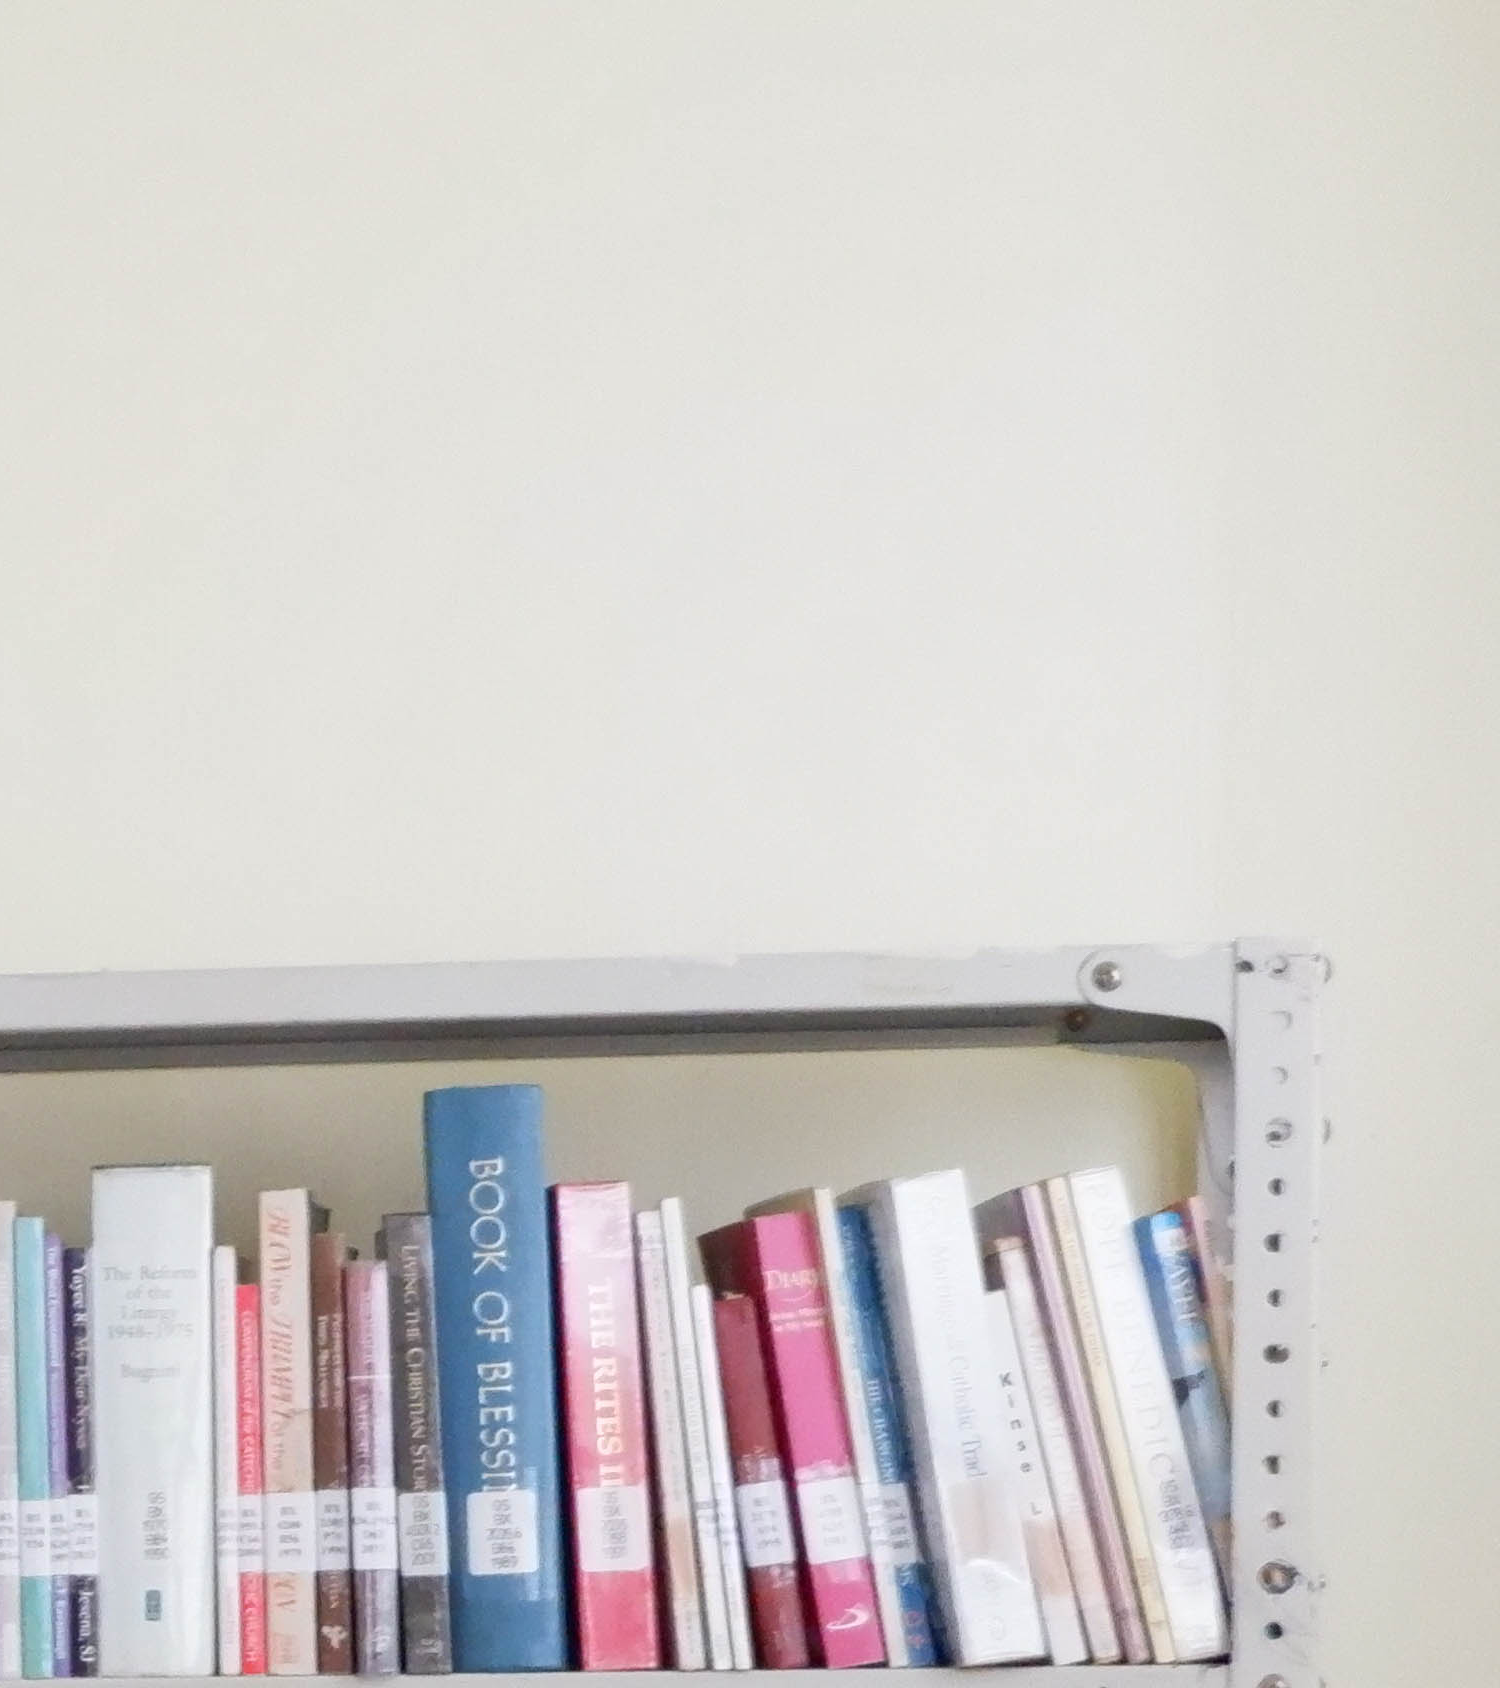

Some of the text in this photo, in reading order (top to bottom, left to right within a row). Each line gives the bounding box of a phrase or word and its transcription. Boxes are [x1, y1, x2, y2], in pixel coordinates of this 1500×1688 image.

[468, 1155, 511, 1352] BOOK OF
[405, 1346, 426, 1440] CHRISTIAN
[584, 1276, 625, 1458] THE RITES
